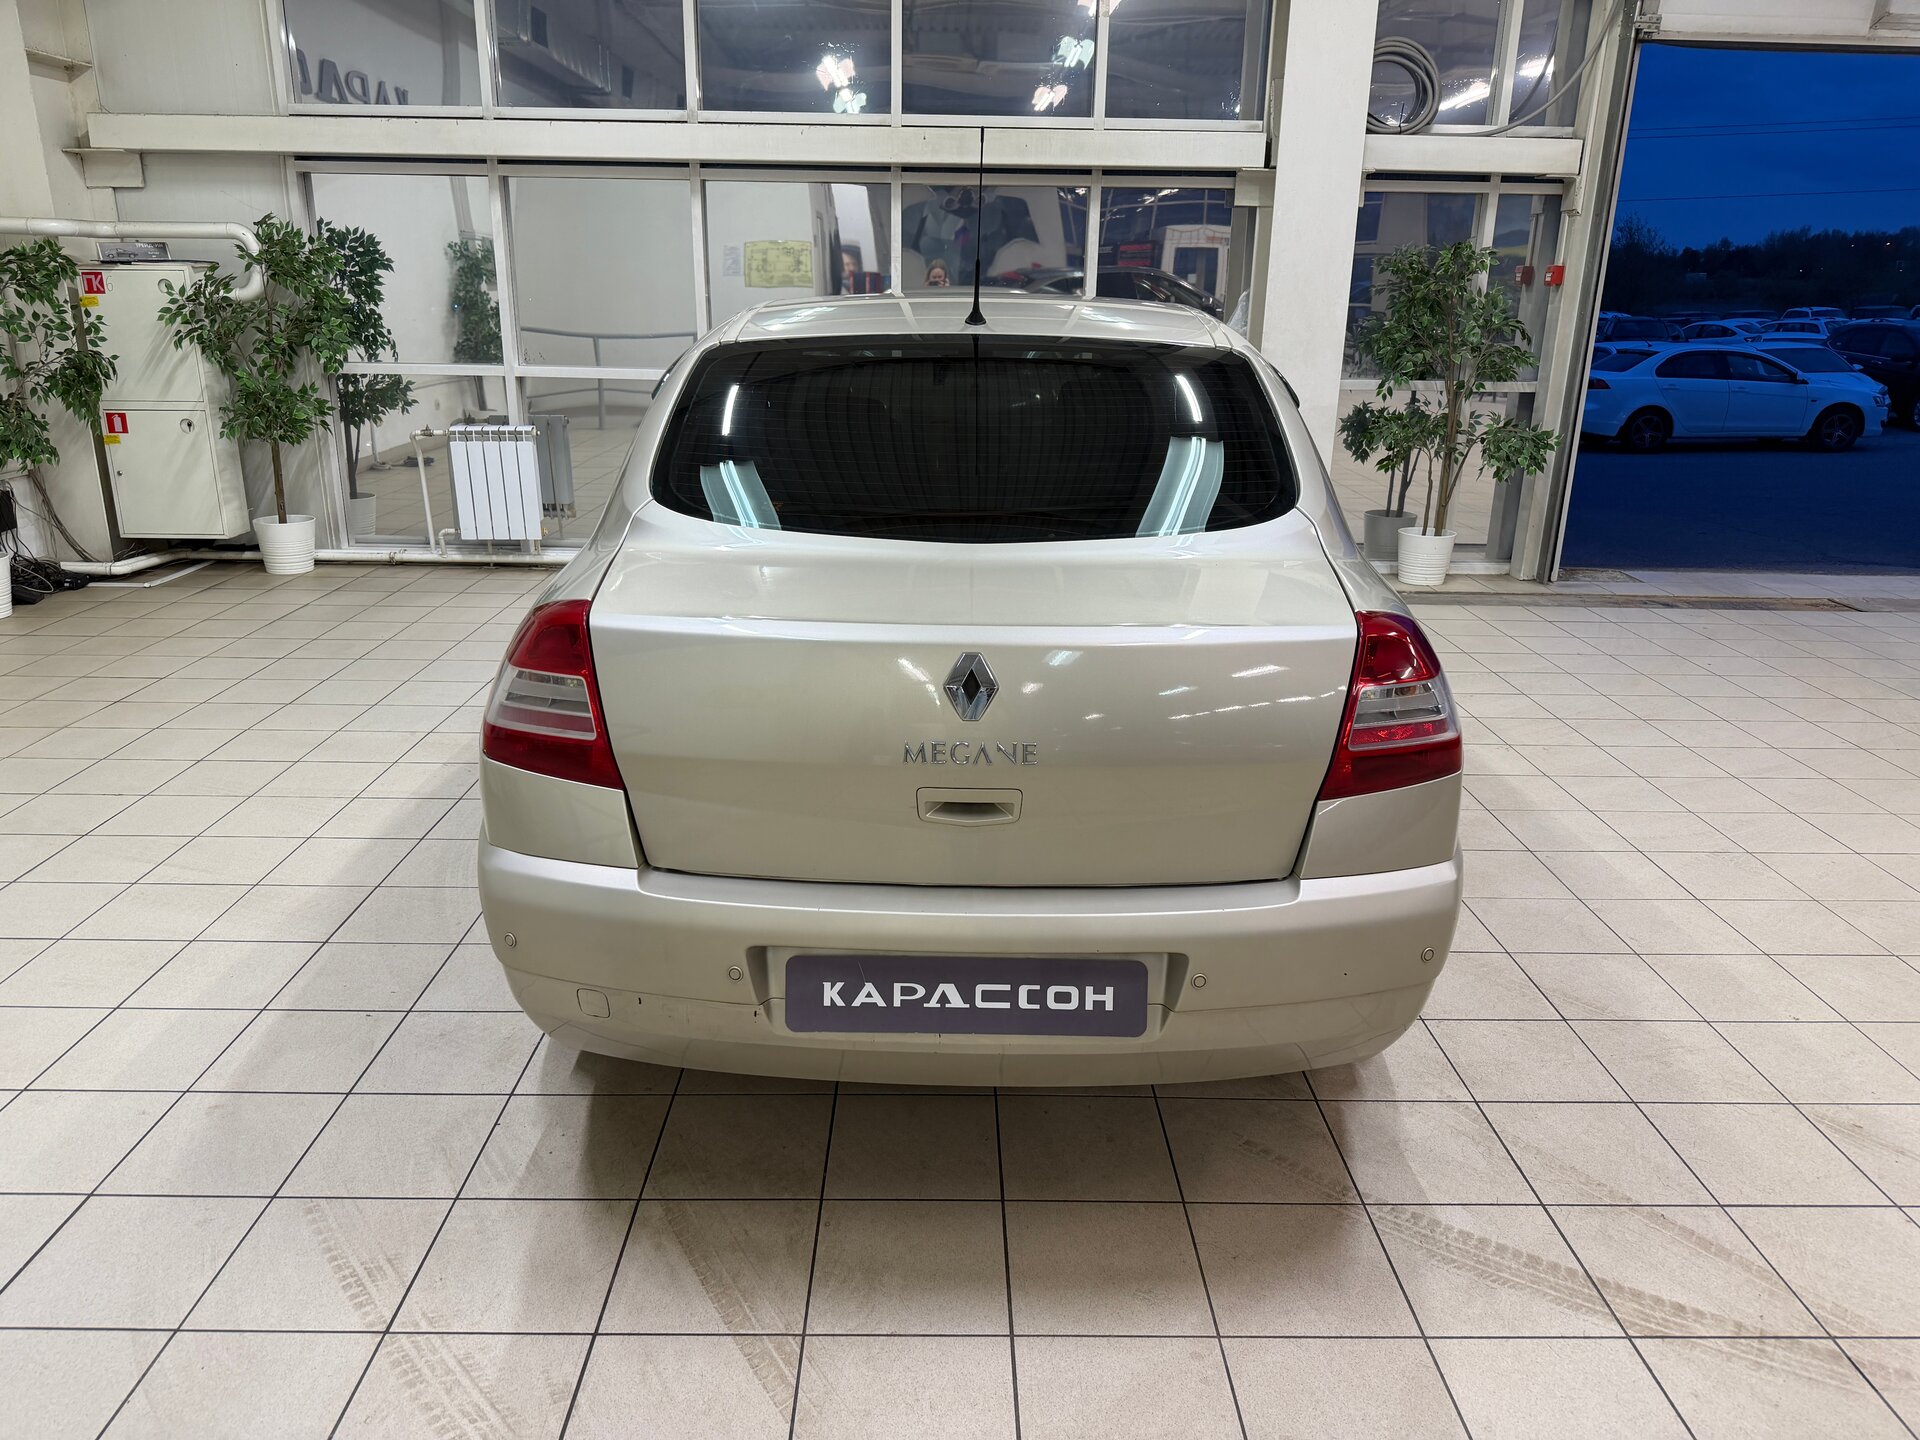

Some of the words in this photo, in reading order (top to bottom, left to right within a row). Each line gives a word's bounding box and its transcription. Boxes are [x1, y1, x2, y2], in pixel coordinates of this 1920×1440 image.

[82, 274, 105, 292] ПК
[106, 275, 114, 292] 6
[903, 740, 1039, 765] MEGANE
[822, 981, 1114, 1011] КАРАССОН
